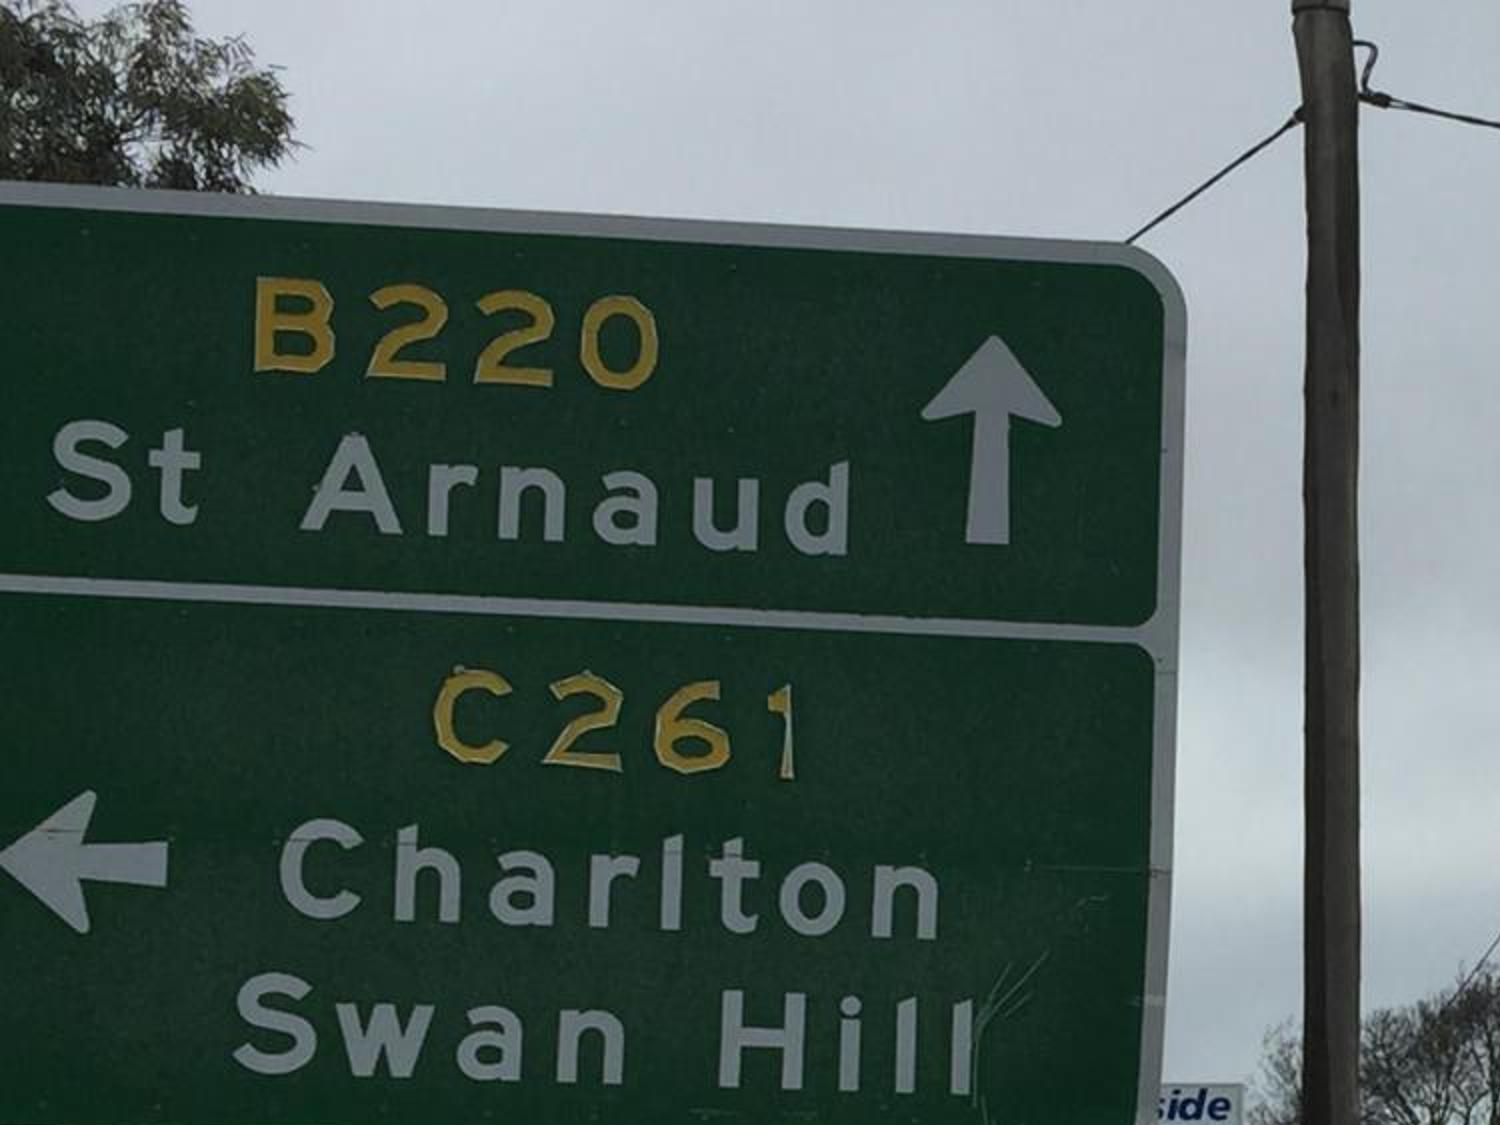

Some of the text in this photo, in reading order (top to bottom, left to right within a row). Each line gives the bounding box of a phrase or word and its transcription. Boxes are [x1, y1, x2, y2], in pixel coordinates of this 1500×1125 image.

[254, 277, 659, 391] B220
[47, 420, 850, 556] St Arnaud
[432, 666, 796, 779] C261
[279, 818, 939, 941] Charlton
[232, 972, 974, 1095] Swan Hill
